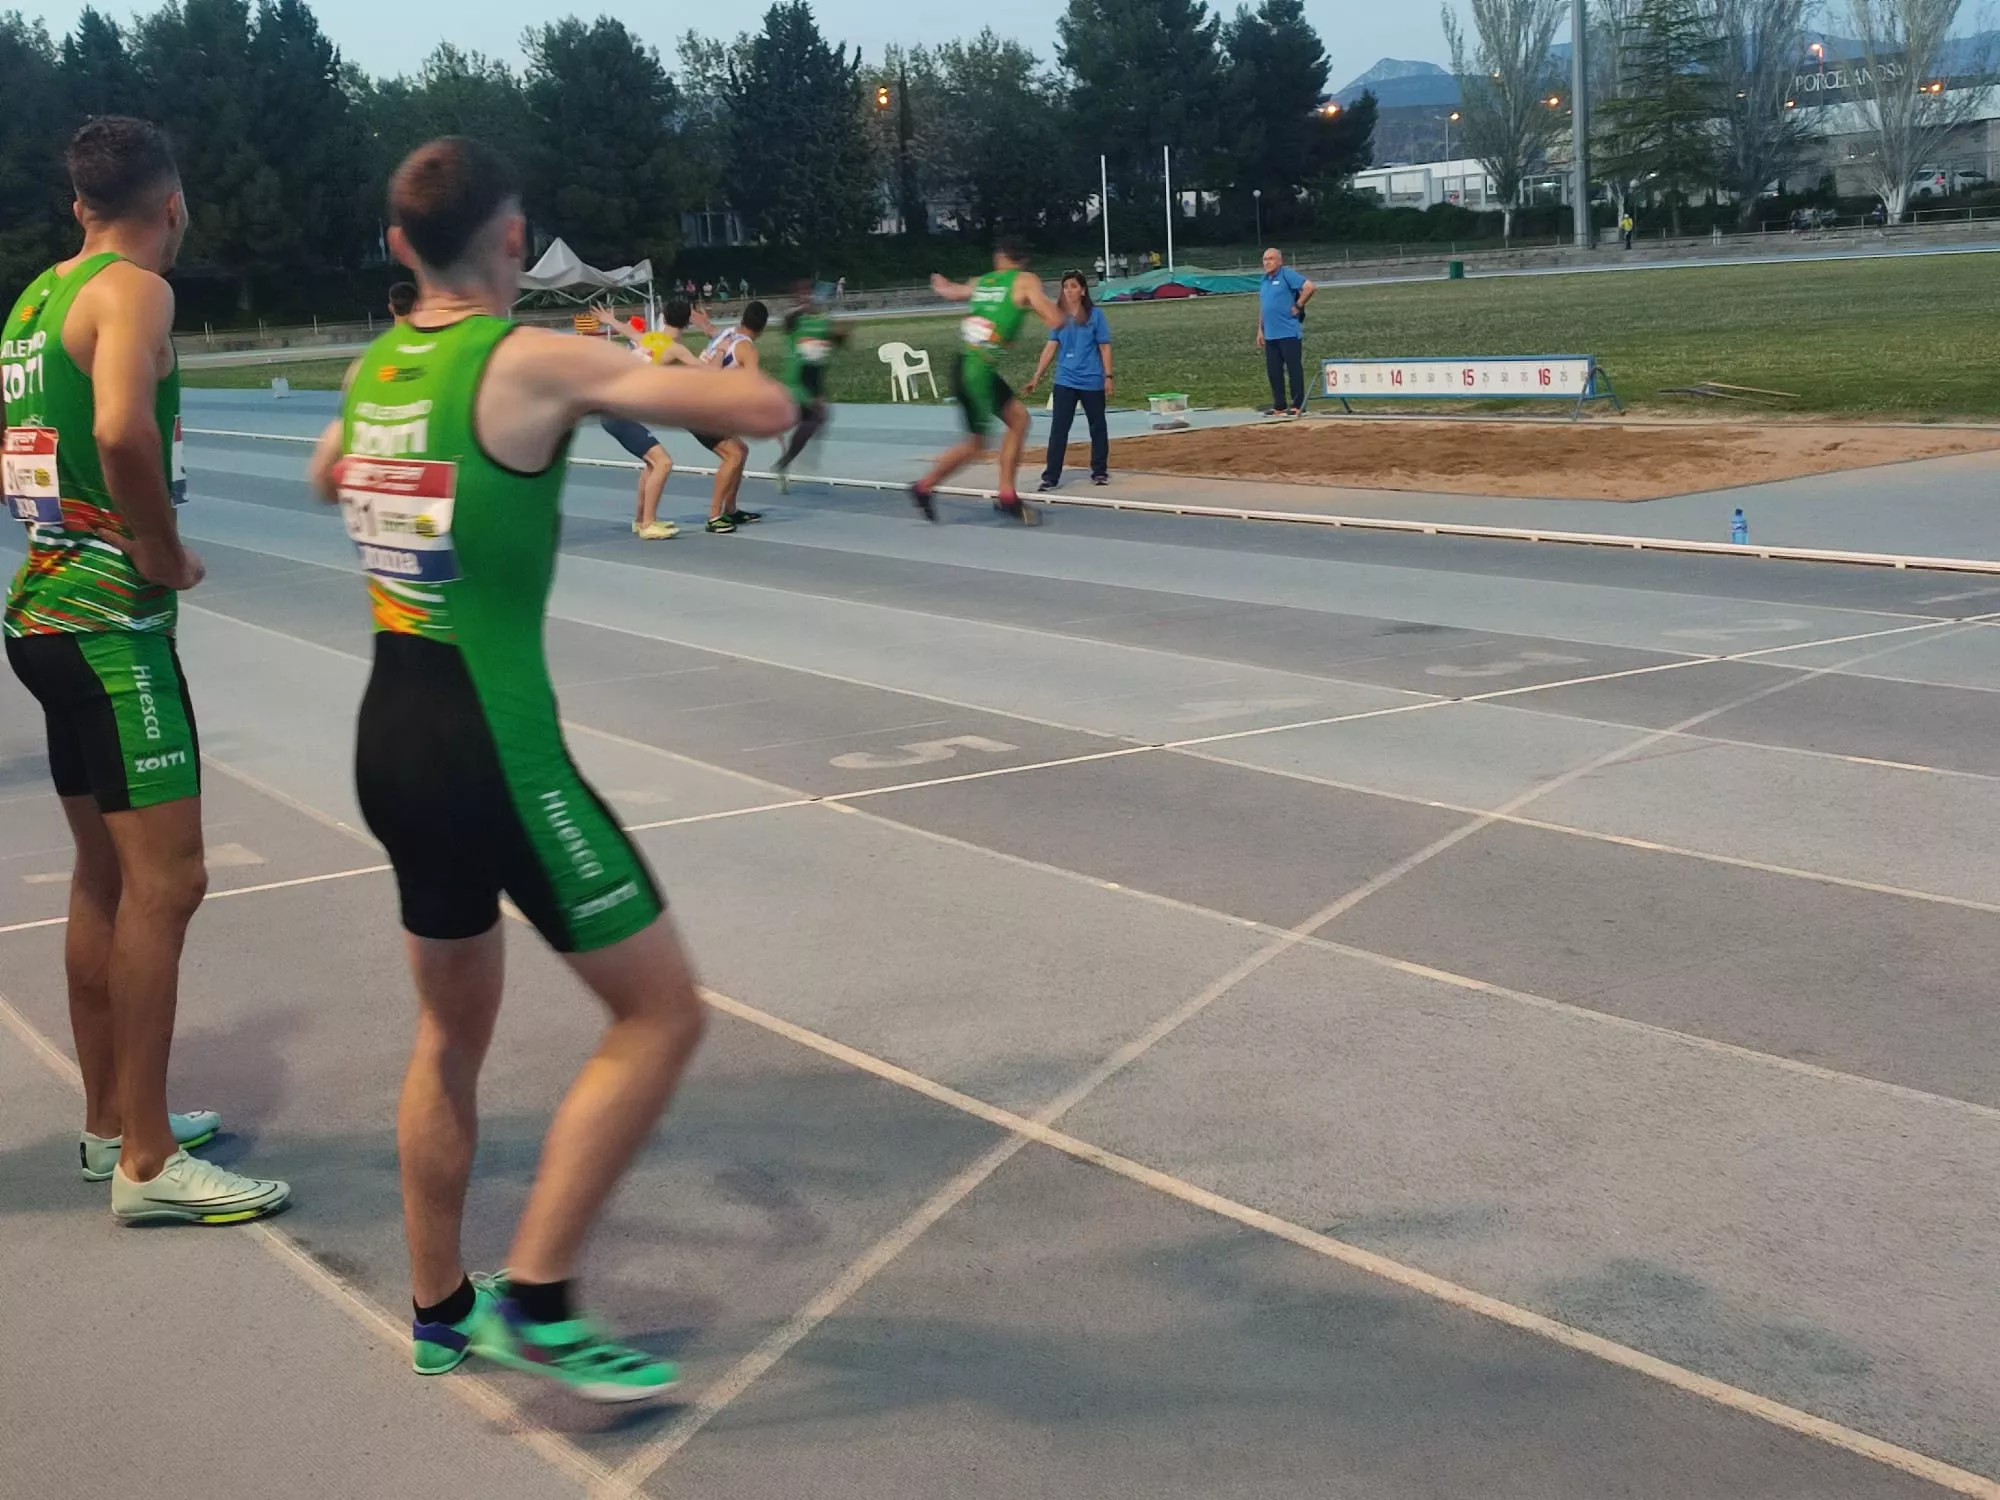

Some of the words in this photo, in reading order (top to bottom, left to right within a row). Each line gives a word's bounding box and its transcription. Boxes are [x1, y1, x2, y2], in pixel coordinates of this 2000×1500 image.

[1326, 370, 1338, 387] 13
[1390, 369, 1403, 387] 14
[1462, 368, 1474, 386] 15
[1538, 367, 1551, 386] 16
[131, 664, 162, 740] Huesca
[829, 735, 1020, 770] 5
